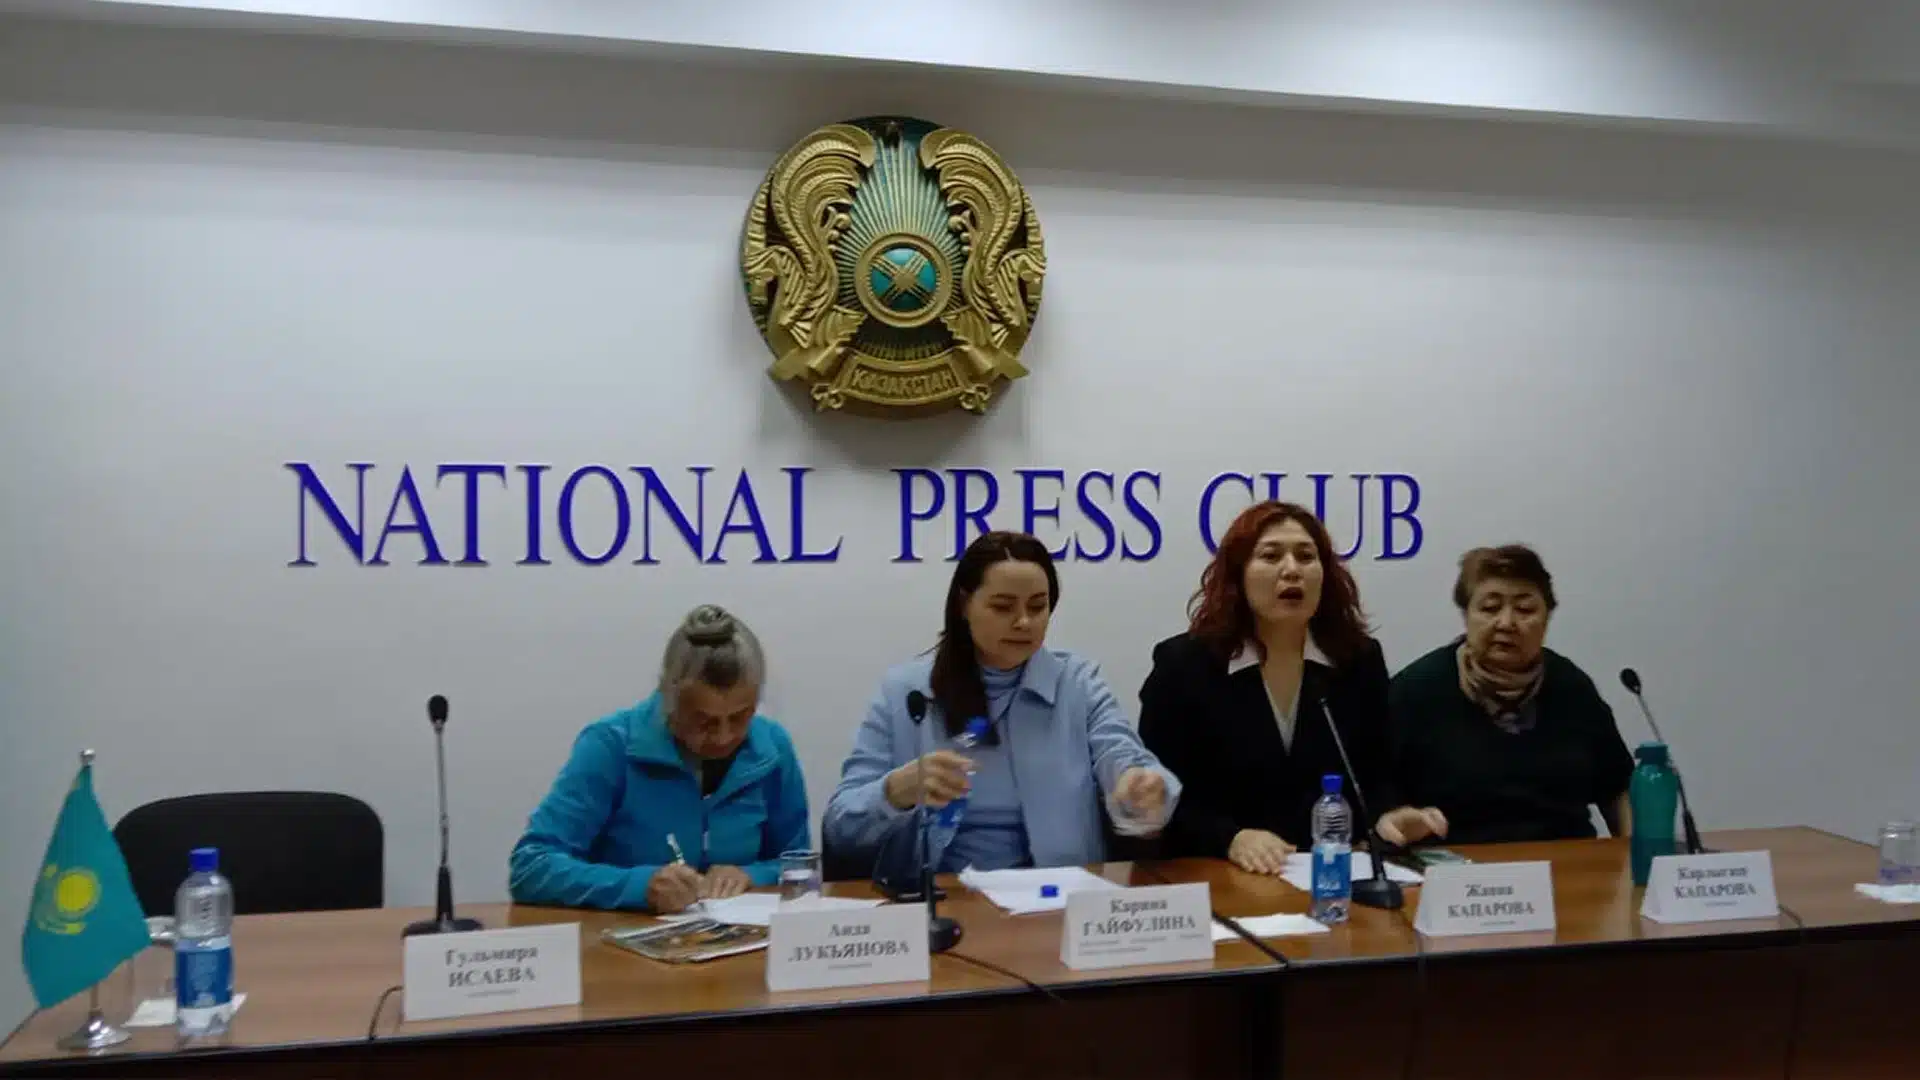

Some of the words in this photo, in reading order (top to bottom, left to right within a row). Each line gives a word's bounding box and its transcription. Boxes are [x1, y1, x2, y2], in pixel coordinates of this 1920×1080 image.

[284, 462, 843, 567] NATIONAL
[891, 467, 1163, 563] PRESS
[1674, 883, 1757, 899] КАПАРОВА
[1109, 899, 1169, 914] Карина
[1448, 902, 1535, 918] КАПАРОВА
[1083, 916, 1197, 936] ГАЙФУЛИНА
[445, 947, 539, 968] Гульмира
[788, 941, 909, 963] ЛУКЬЯНОВА
[448, 967, 536, 988] ИСАЕВА
